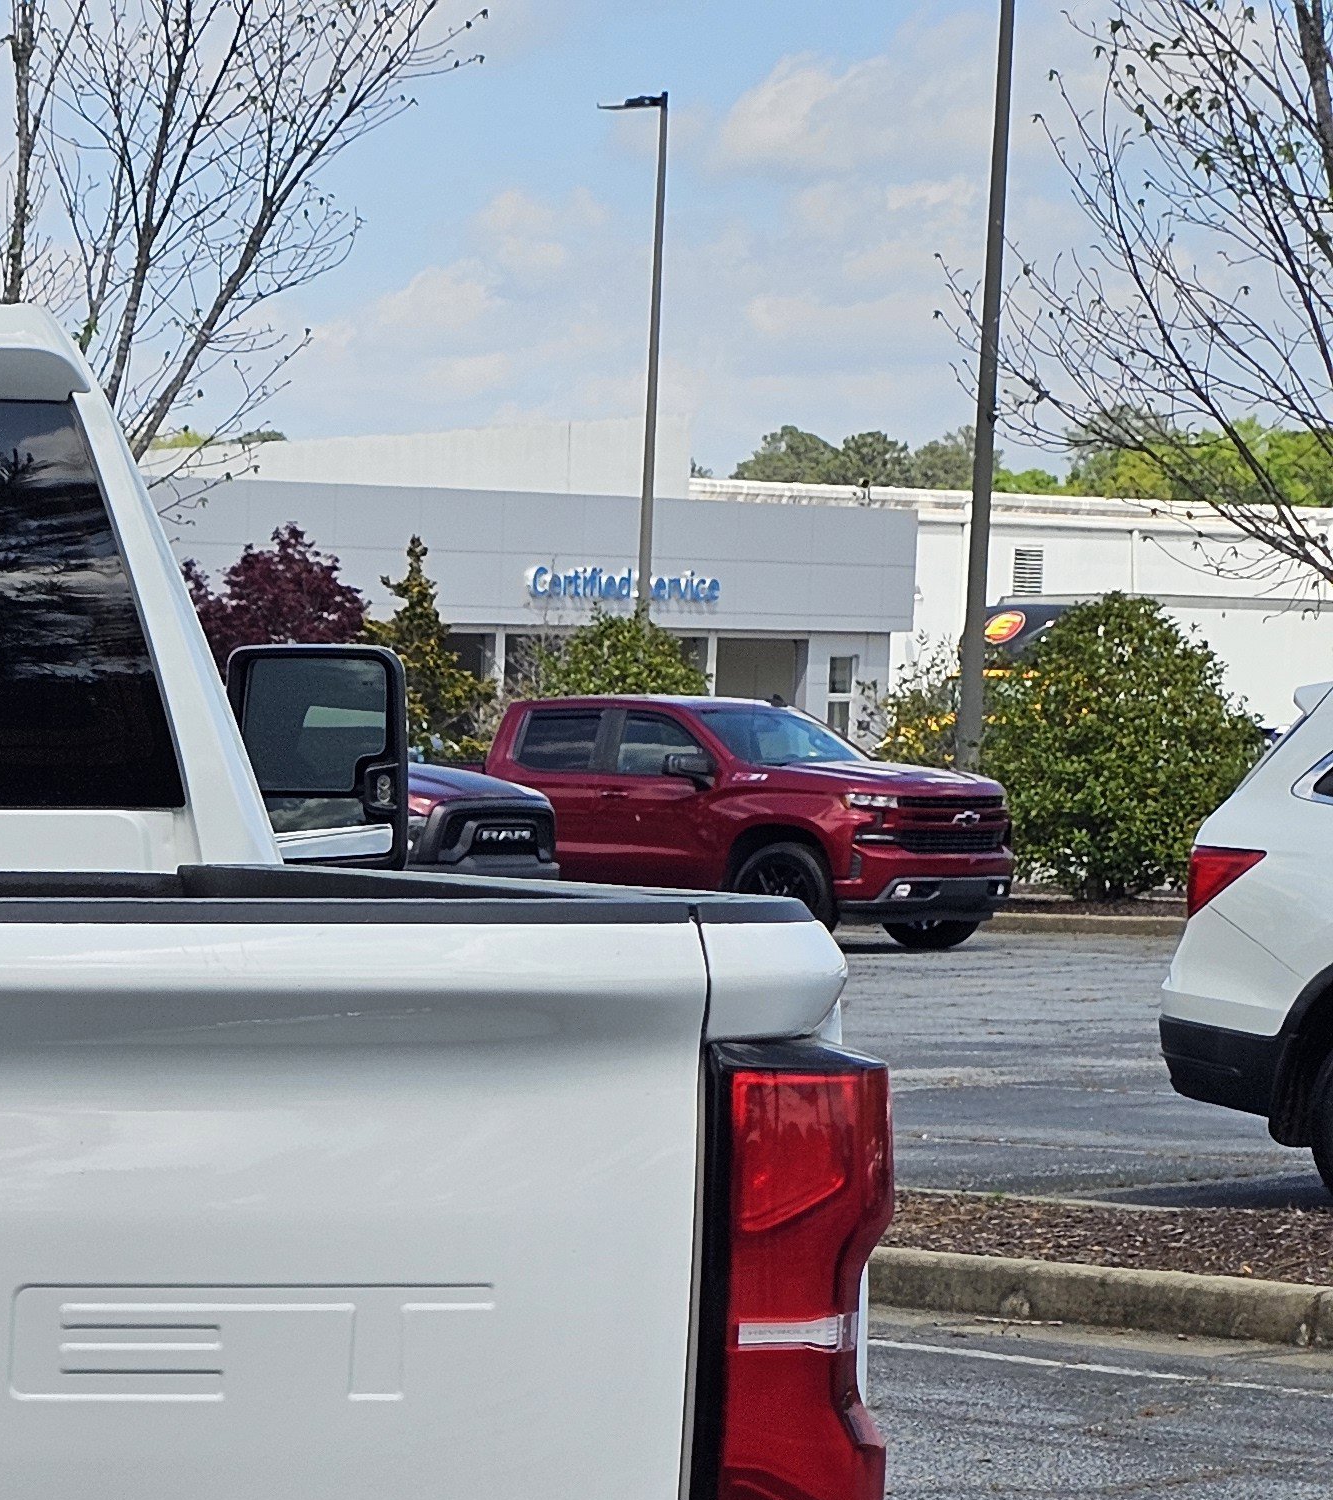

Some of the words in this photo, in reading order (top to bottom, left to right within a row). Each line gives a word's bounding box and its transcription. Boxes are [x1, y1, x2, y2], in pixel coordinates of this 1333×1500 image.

[532, 566, 632, 599] Certified
[650, 570, 721, 602] ervice
[481, 829, 531, 841] RAM
